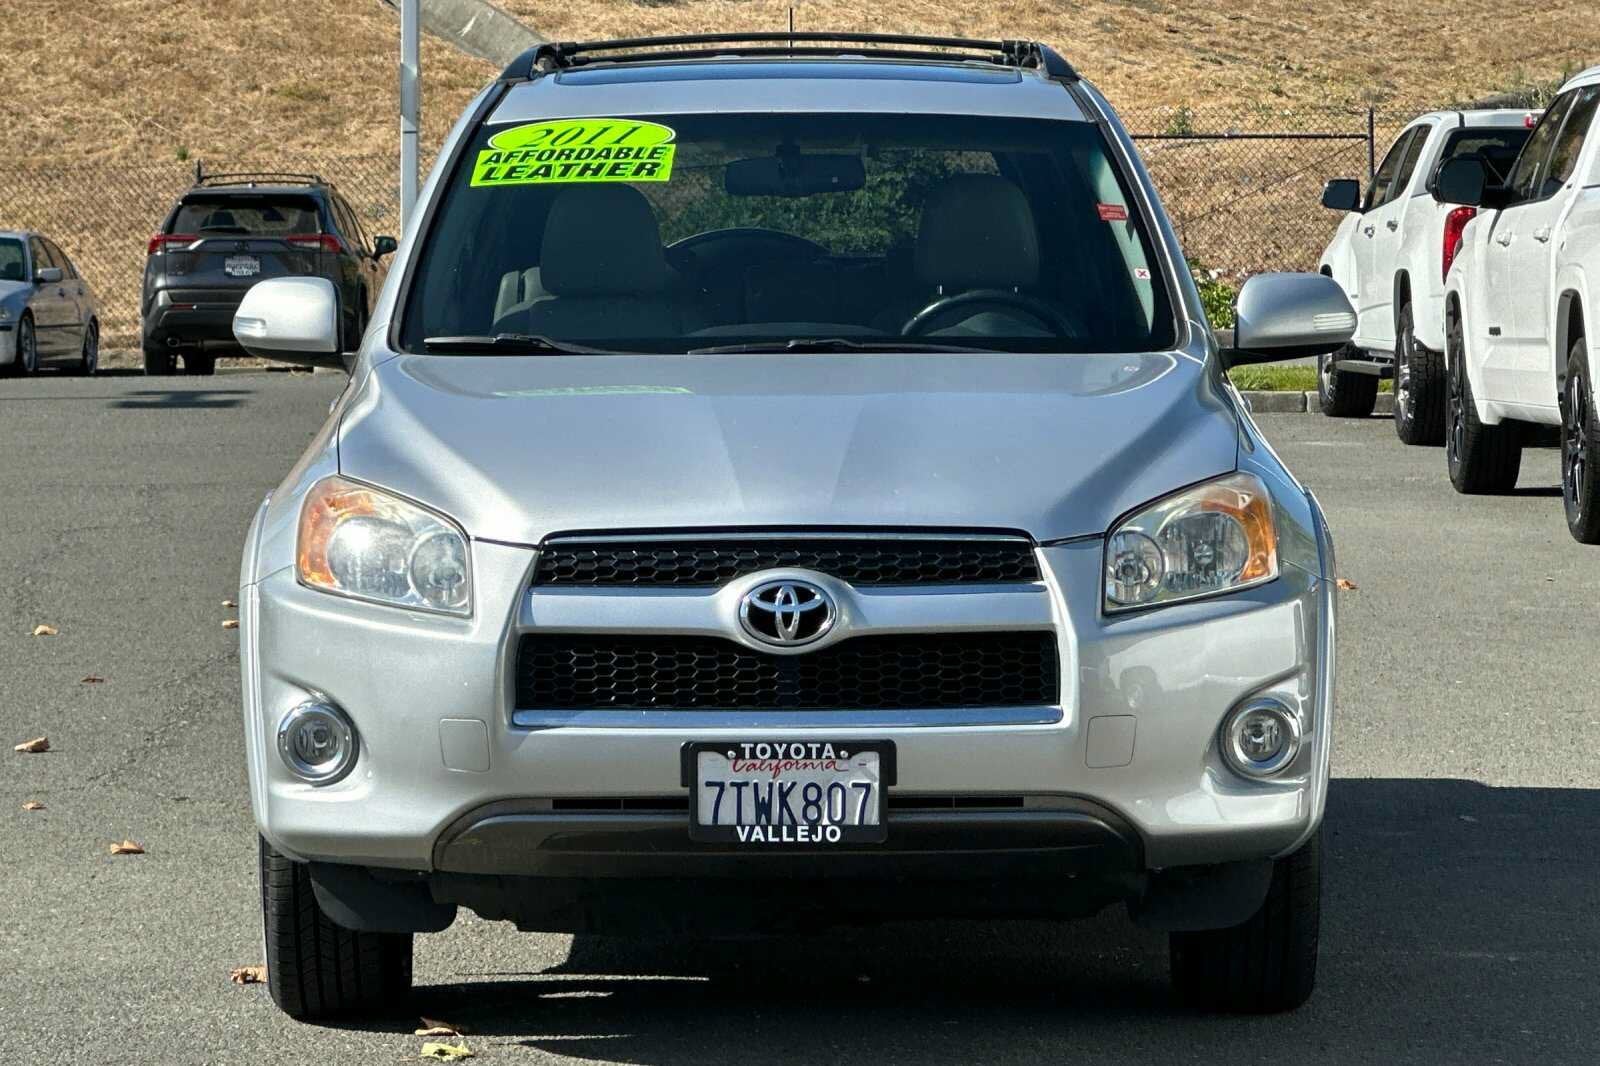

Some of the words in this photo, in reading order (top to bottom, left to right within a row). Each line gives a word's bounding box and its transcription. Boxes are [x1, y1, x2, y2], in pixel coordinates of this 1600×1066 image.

[517, 125, 643, 148] 2011
[482, 146, 668, 165] AFFORDABLE
[480, 161, 662, 181] LEATHER
[740, 743, 836, 760] TOYOTA
[705, 781, 871, 825] 7TWK807
[736, 825, 842, 842] VALLEJO
